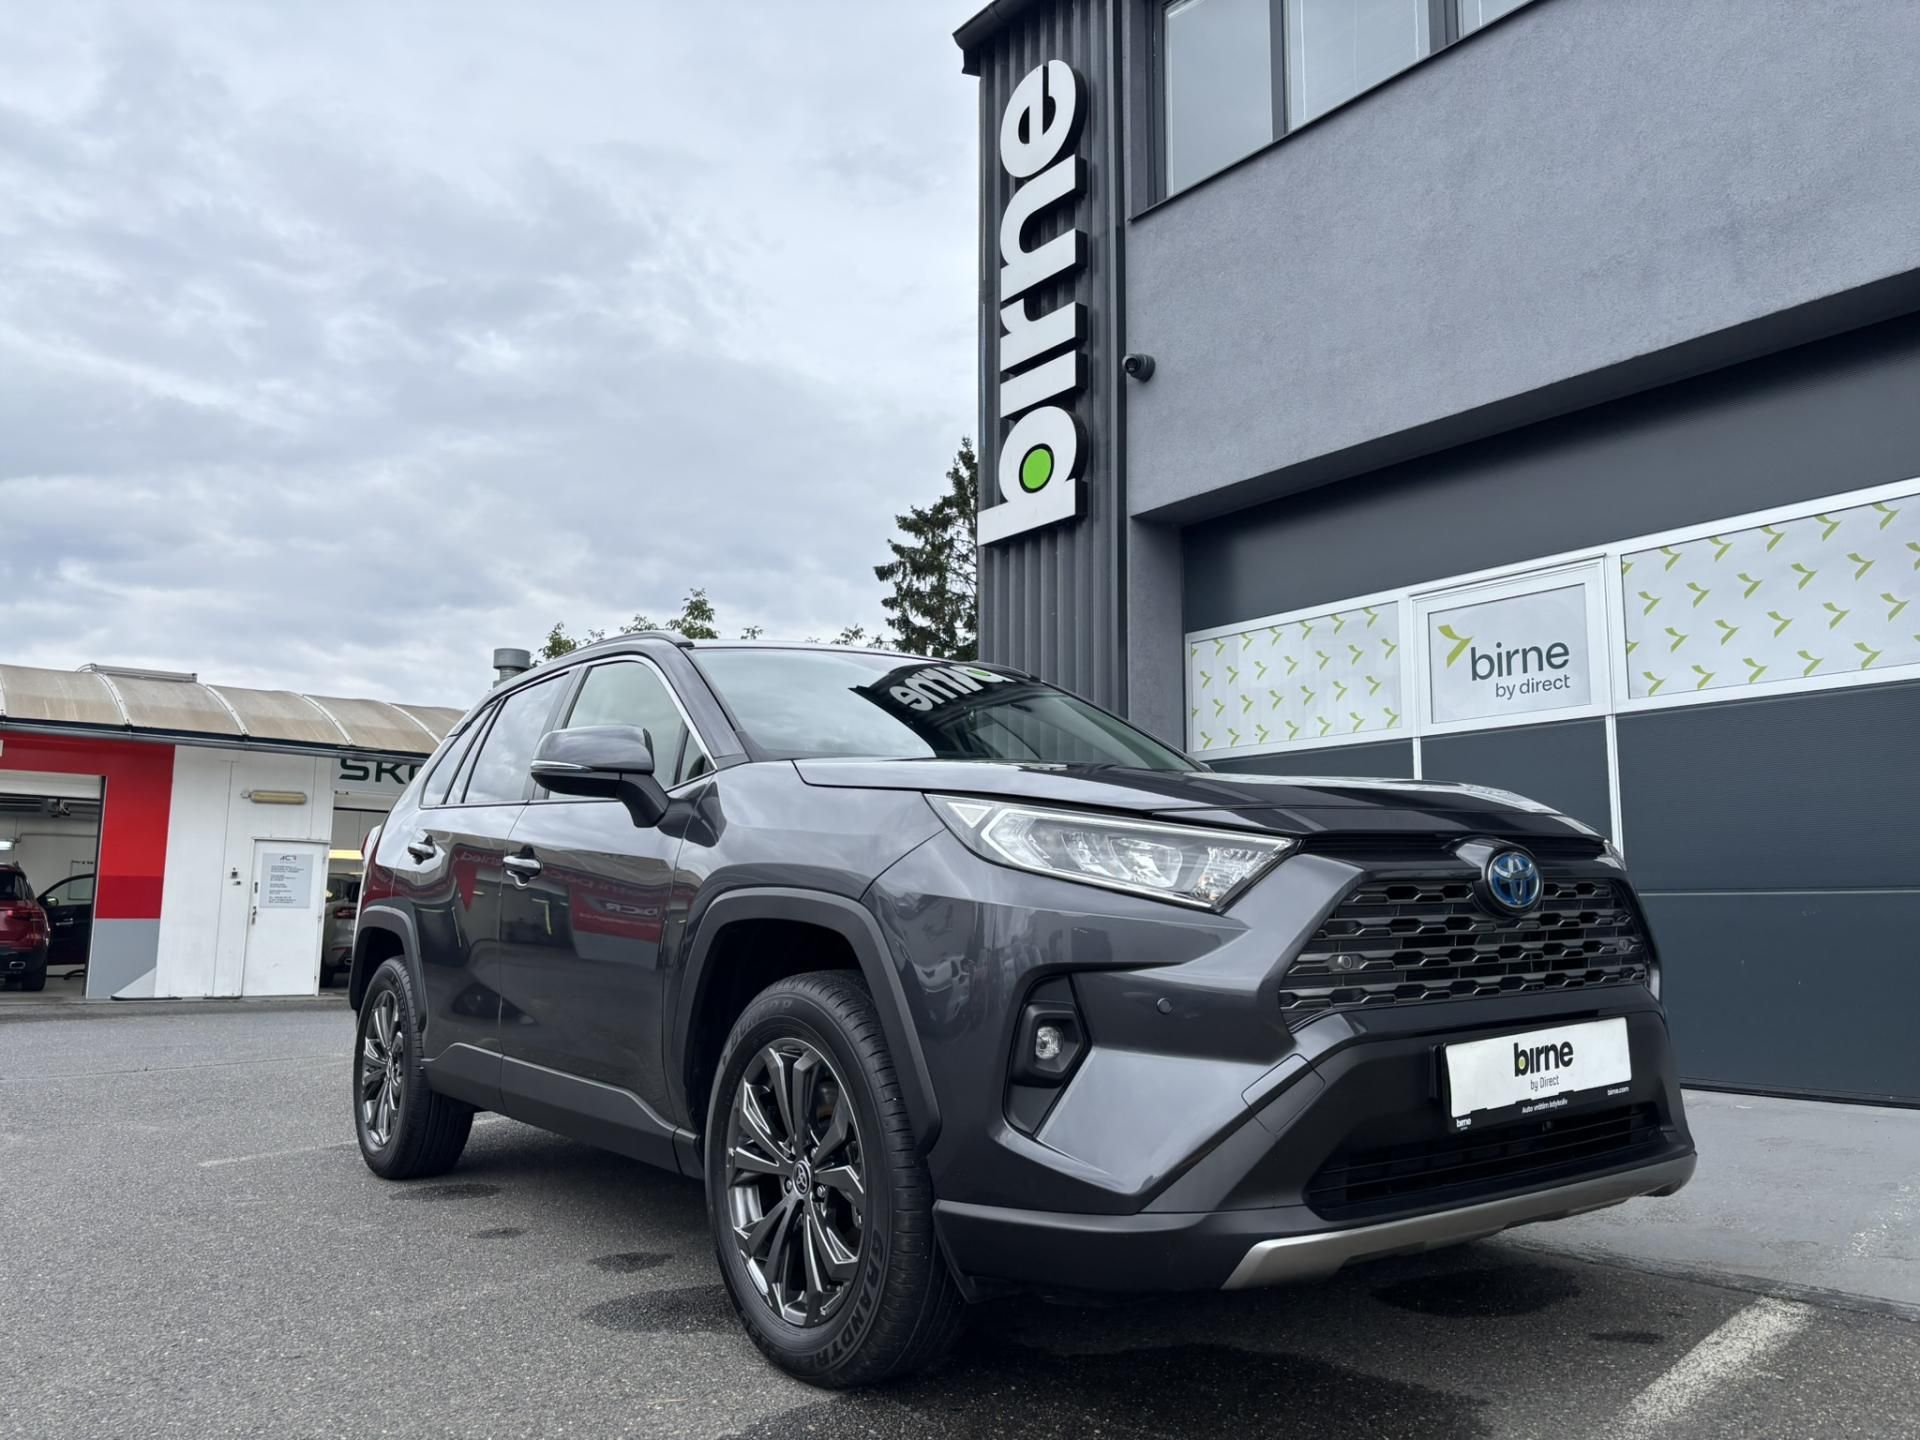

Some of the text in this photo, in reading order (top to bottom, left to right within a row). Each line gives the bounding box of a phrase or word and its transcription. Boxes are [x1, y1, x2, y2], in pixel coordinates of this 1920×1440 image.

[977, 59, 1080, 546] birne
[1471, 641, 1570, 681] birne
[1495, 674, 1571, 700] by direct
[339, 757, 422, 784] SK
[1513, 1041, 1574, 1077] birne
[1530, 1075, 1560, 1091] by Direct
